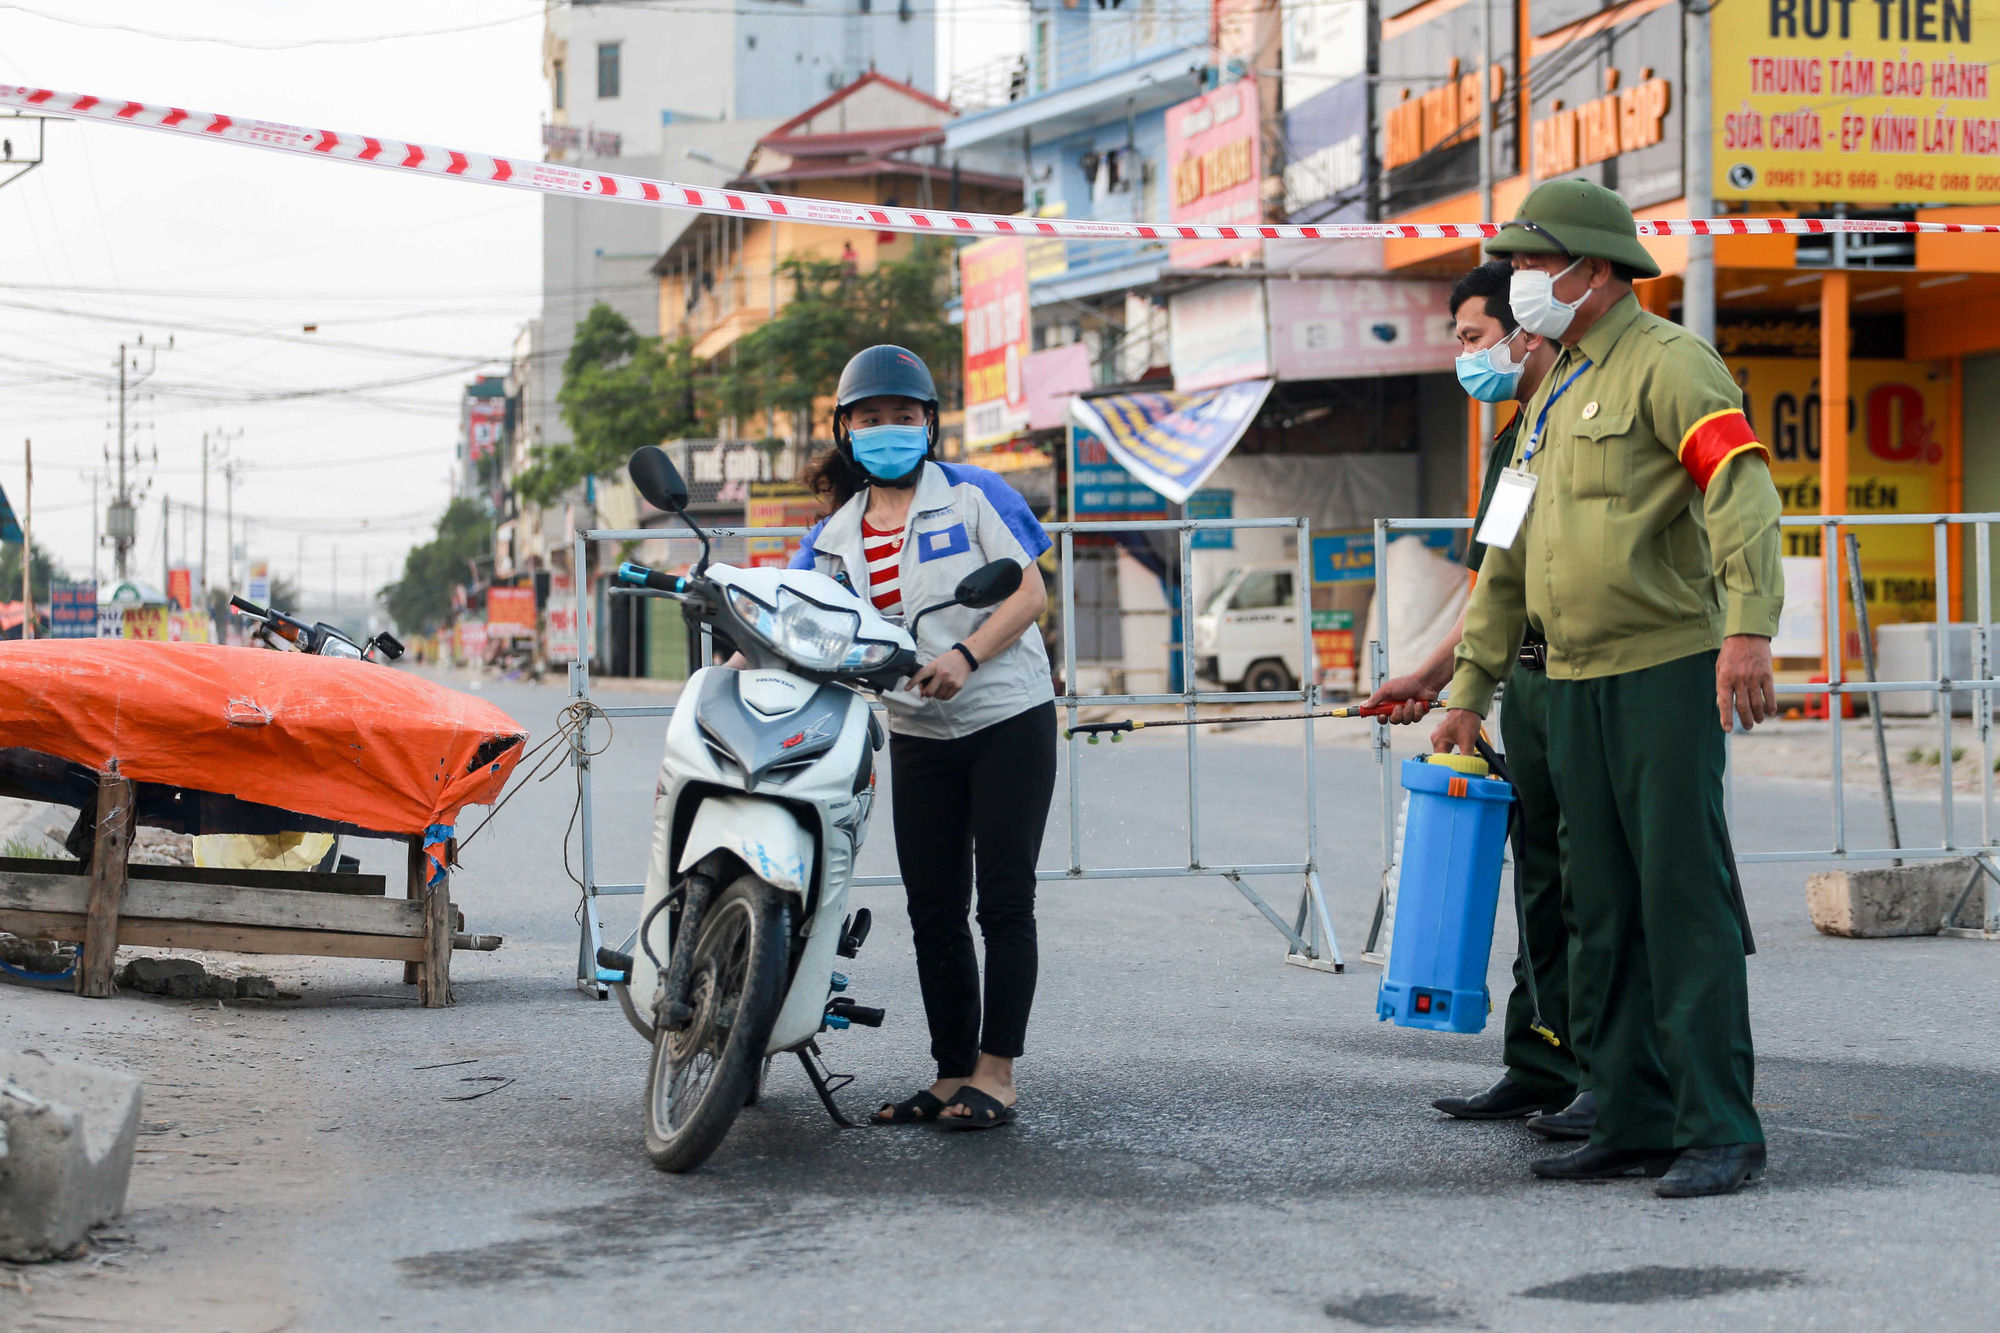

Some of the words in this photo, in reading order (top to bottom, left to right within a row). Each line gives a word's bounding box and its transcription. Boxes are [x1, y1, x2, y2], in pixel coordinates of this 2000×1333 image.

[1749, 56, 1822, 96] TRUNG
[1829, 50, 1875, 97] TÂM
[1882, 47, 1924, 98] BẢO
[1931, 52, 1988, 99] HÀNH
[1533, 99, 1580, 181] BÁN
[1577, 66, 1621, 167] TRẢ
[1620, 66, 1671, 152] GÓP
[1724, 99, 1764, 151] SỬA
[1769, 104, 1823, 151] CHỮA
[1840, 106, 1865, 153] ÉP
[1870, 106, 1918, 154] KÍNH
[1922, 102, 1958, 155] LẤY
[1962, 117, 2000, 157] NGA
[1764, 167, 1805, 189] 0961
[1811, 169, 1842, 189] 343
[1847, 170, 1878, 190] 666
[1894, 171, 1935, 191] 0942
[756, 677, 796, 690] HONDA
